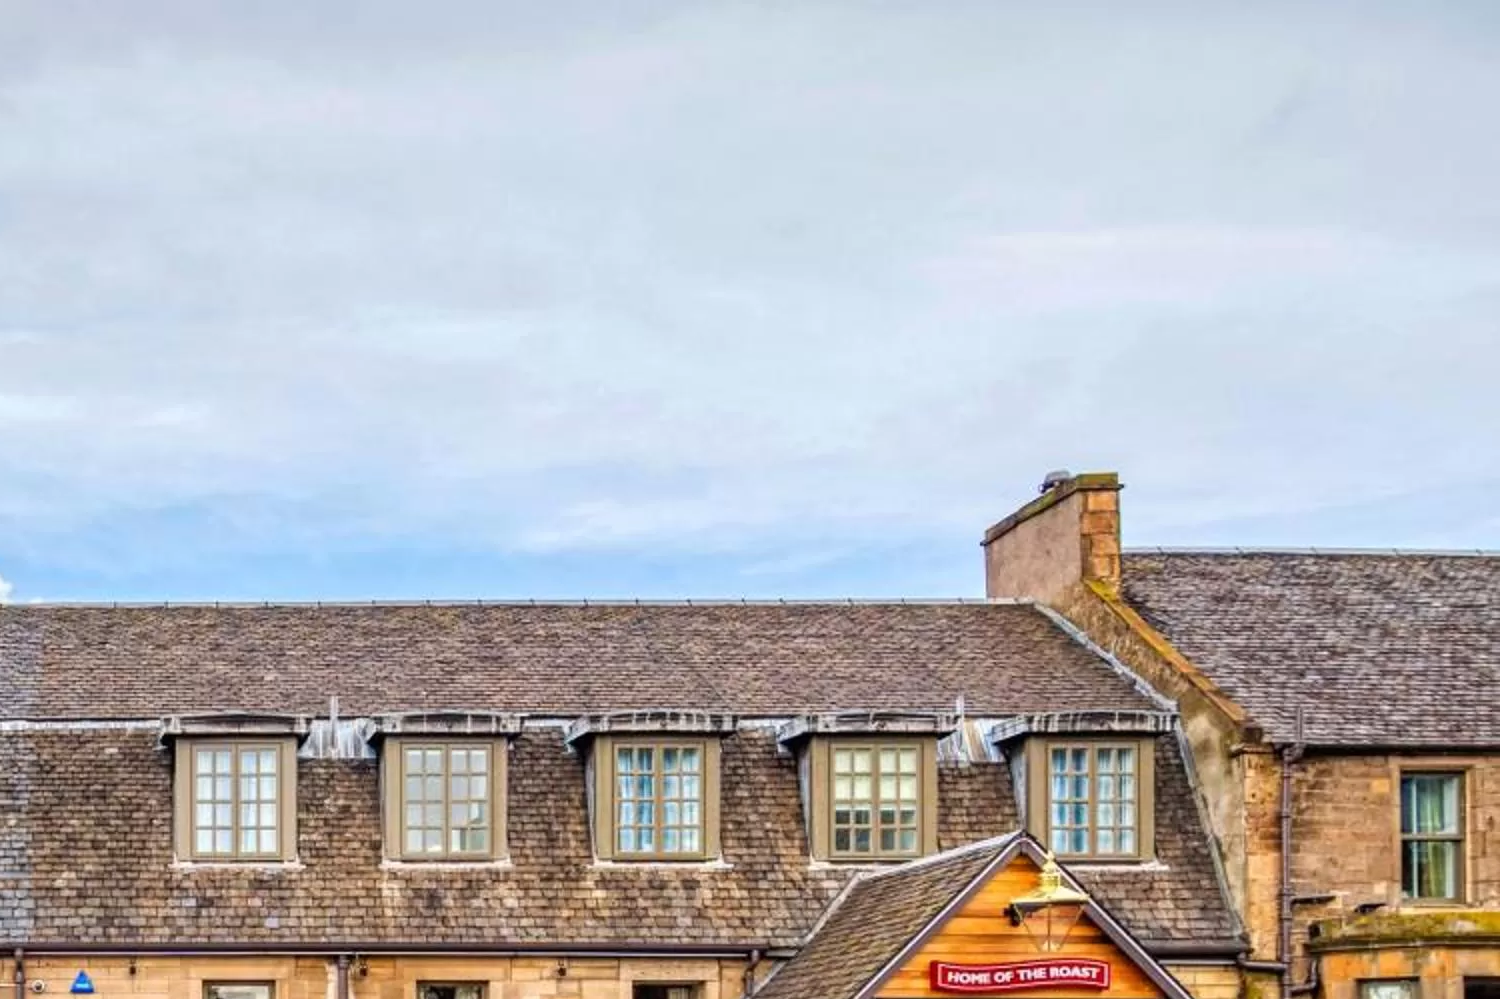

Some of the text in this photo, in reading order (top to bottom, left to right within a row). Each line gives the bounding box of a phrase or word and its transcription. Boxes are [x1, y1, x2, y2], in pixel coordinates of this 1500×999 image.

[947, 965, 1101, 984] HOME OF THE ROAST
